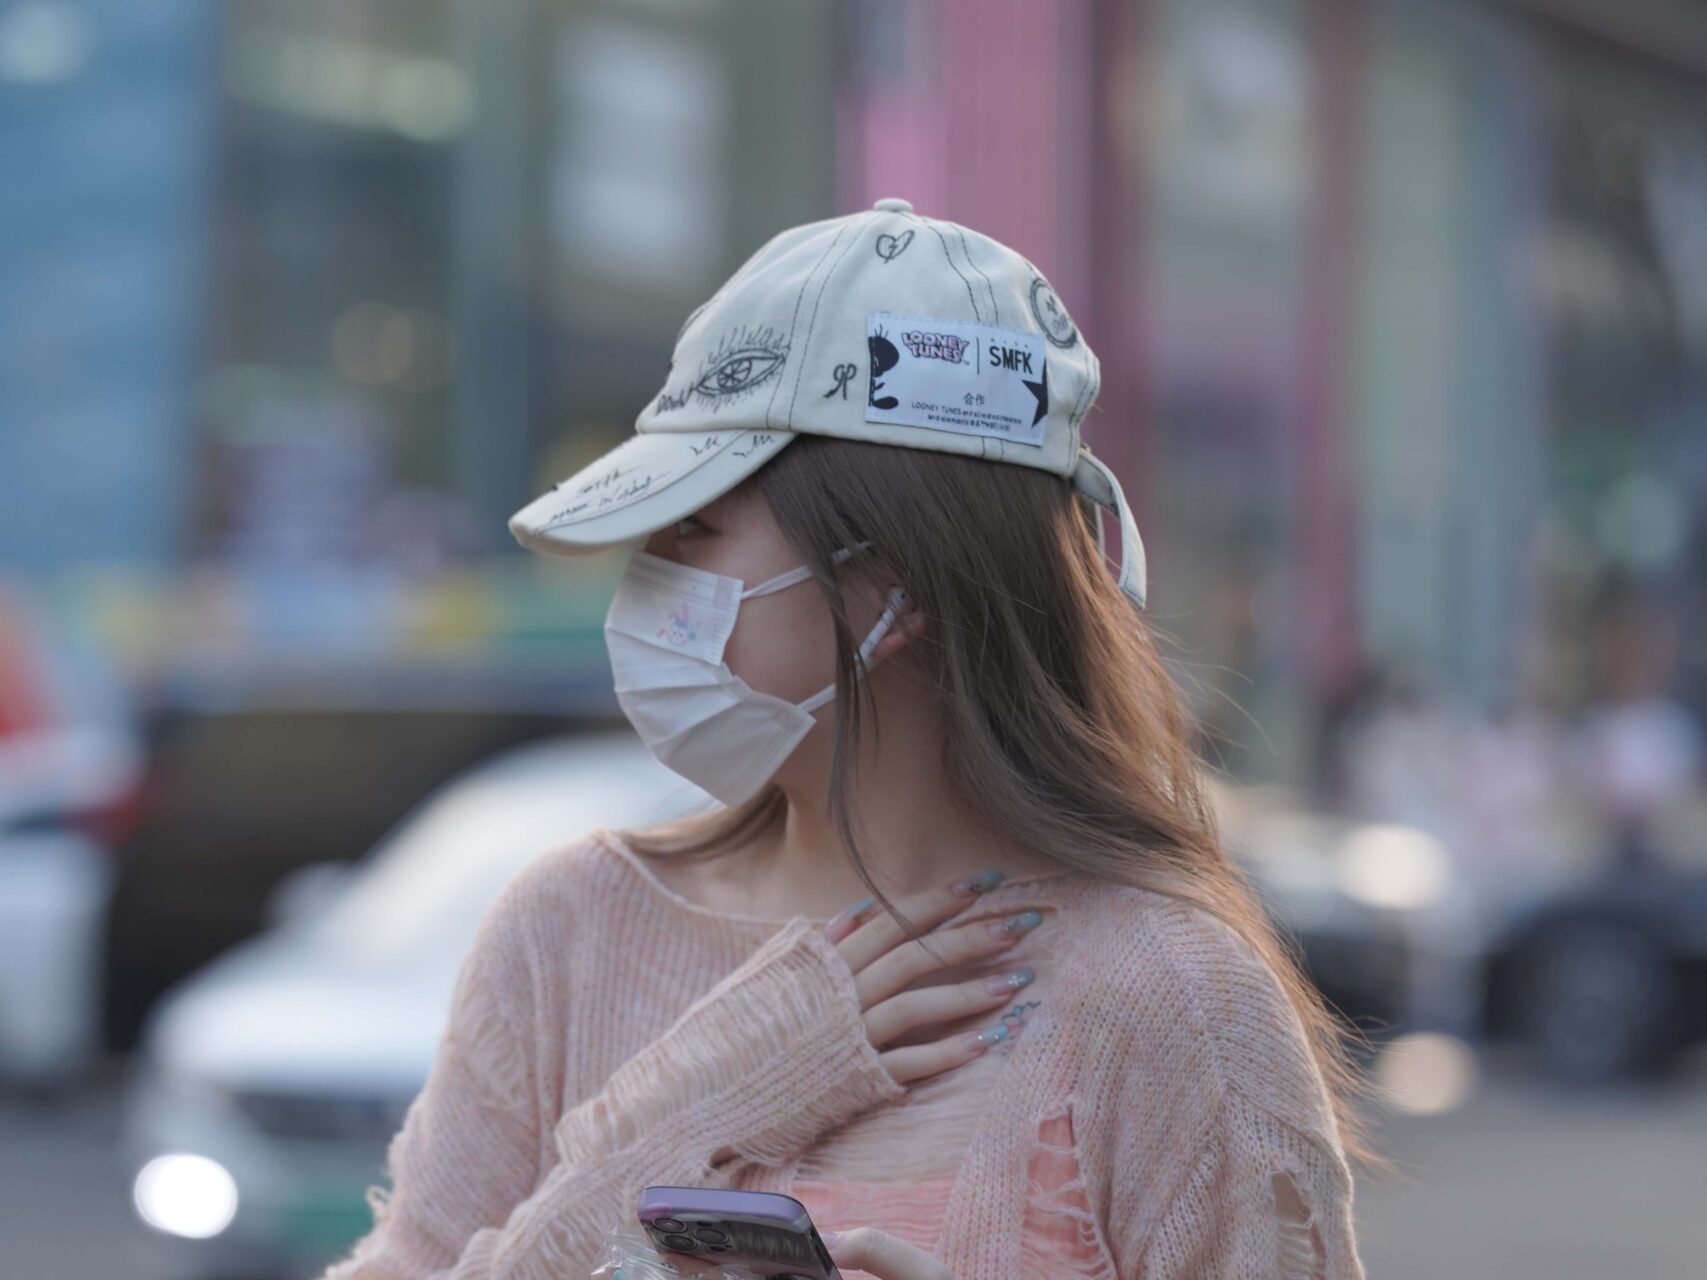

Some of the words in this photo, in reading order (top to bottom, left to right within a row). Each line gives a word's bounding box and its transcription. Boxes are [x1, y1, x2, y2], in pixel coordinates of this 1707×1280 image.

[901, 330, 970, 354] LOONEY
[908, 342, 963, 364] TUNES
[989, 345, 1033, 375] SMFK
[911, 402, 939, 411] LOONEY
[941, 405, 962, 415] TUNES
[963, 392, 985, 407] 合作
